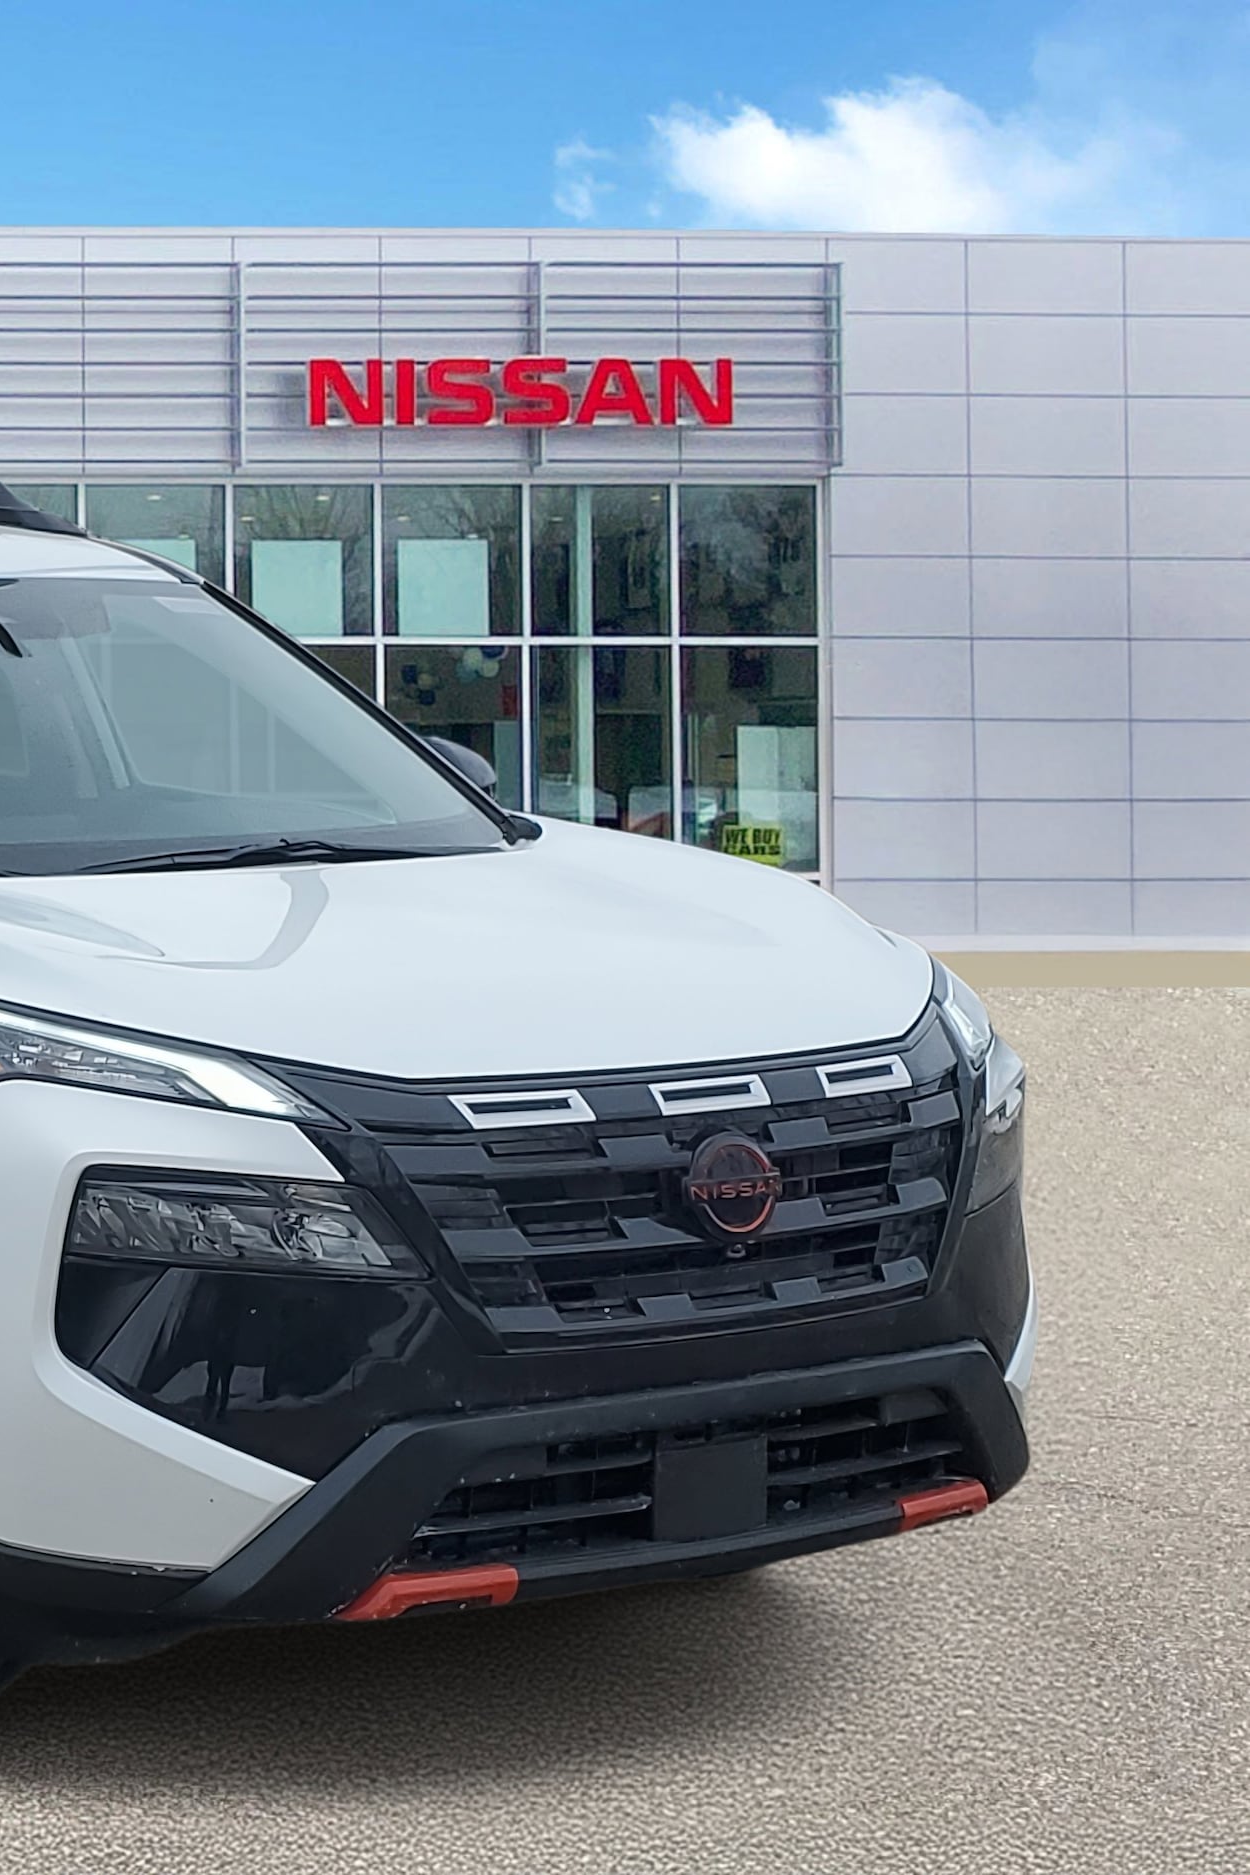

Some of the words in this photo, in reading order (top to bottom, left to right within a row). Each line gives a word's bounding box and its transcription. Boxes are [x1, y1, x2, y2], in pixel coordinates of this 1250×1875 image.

[307, 358, 733, 428] NISSAN
[725, 828, 748, 845] WE
[753, 828, 781, 845] BUY
[724, 845, 781, 855] CARS
